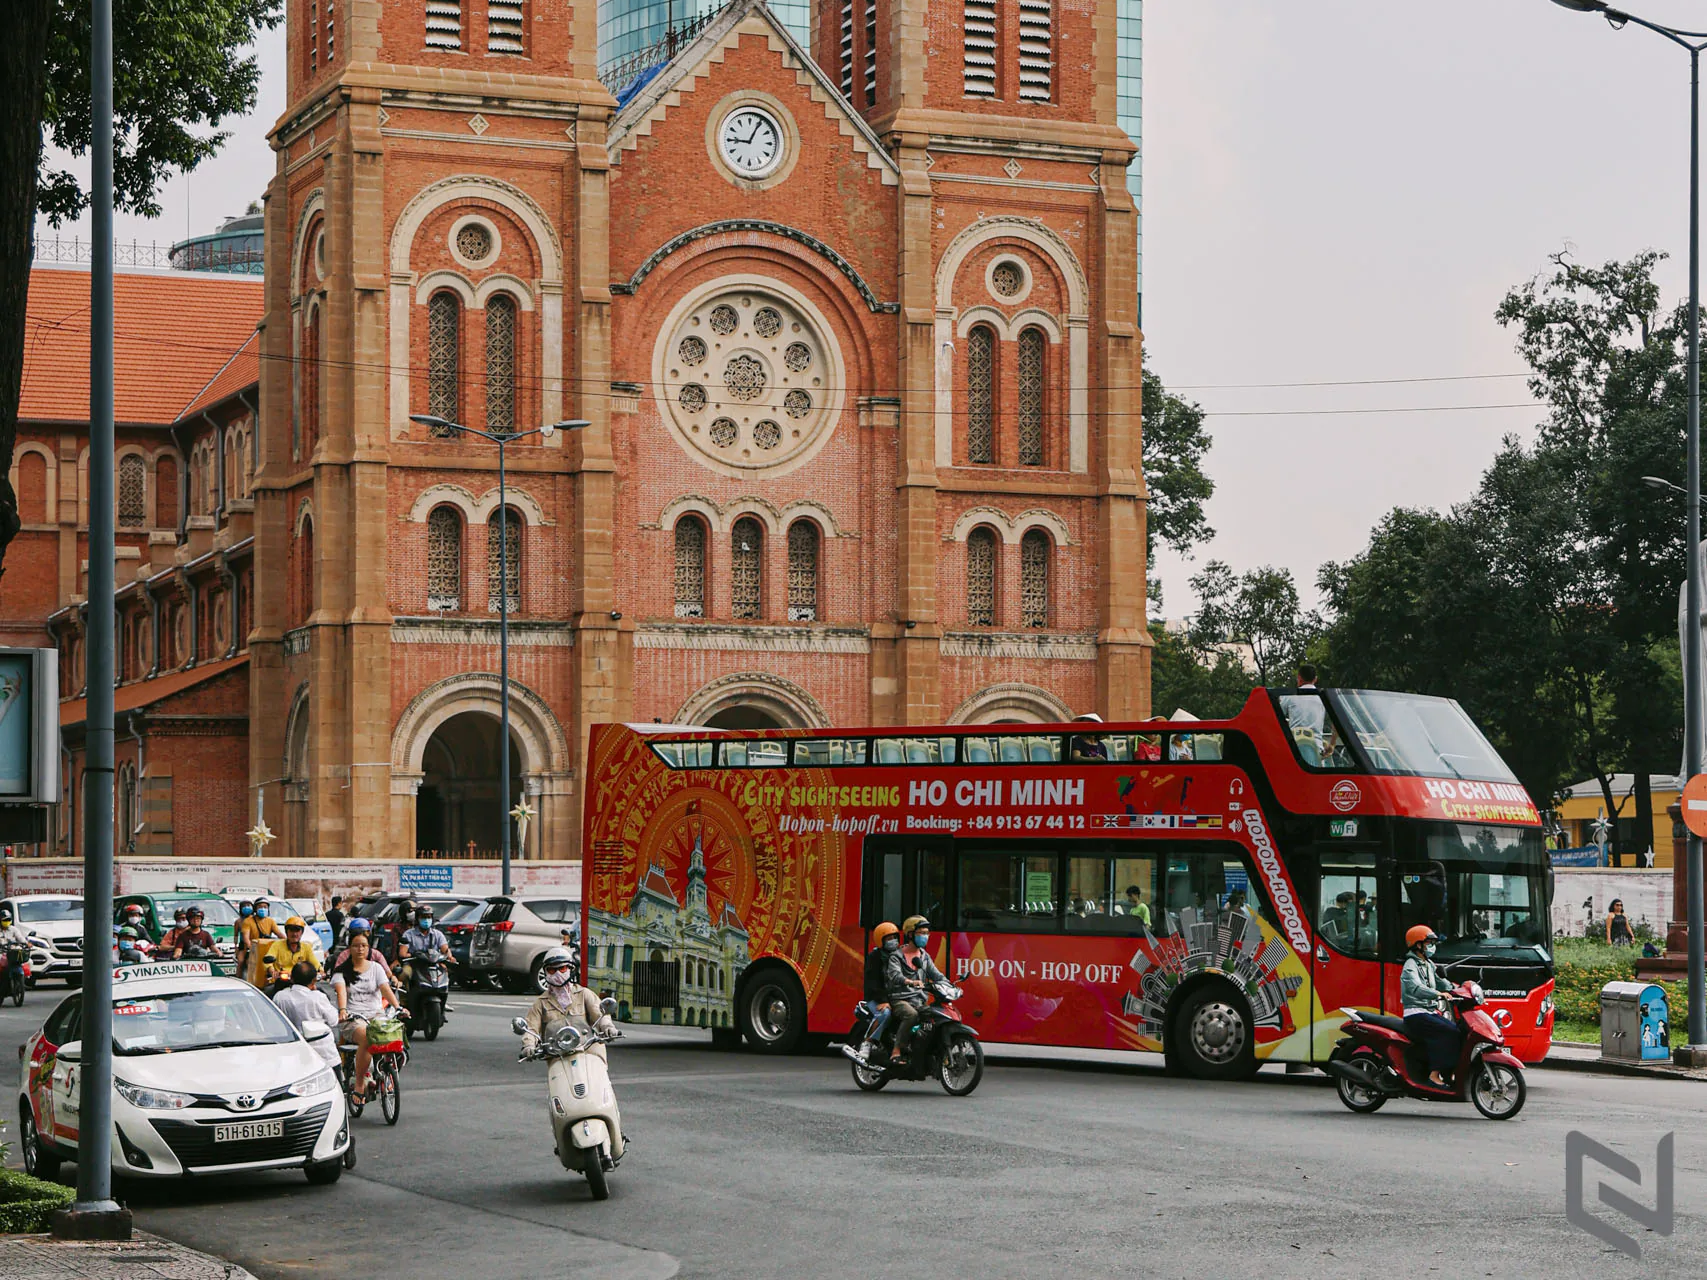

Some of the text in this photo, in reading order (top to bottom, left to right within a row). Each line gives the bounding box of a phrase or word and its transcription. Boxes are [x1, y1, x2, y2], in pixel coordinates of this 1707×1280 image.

[790, 786, 900, 807] SIGHTSEEING
[908, 779, 1085, 806] HO CHI MINH
[1424, 781, 1457, 799] HO
[1458, 781, 1492, 800] CHI
[779, 814, 899, 835] Hopon-hopoff.vn
[906, 815, 1085, 832] Booking: +84 913 67 44 12
[1244, 809, 1310, 952] HOPON-HOPOFF
[132, 963, 208, 978] VINASUN TAXI
[957, 958, 995, 977] HOP
[999, 960, 1025, 978] ON
[1041, 962, 1081, 982] HOP
[1085, 964, 1123, 984] OFF
[217, 1122, 281, 1140] 51H-619.15
